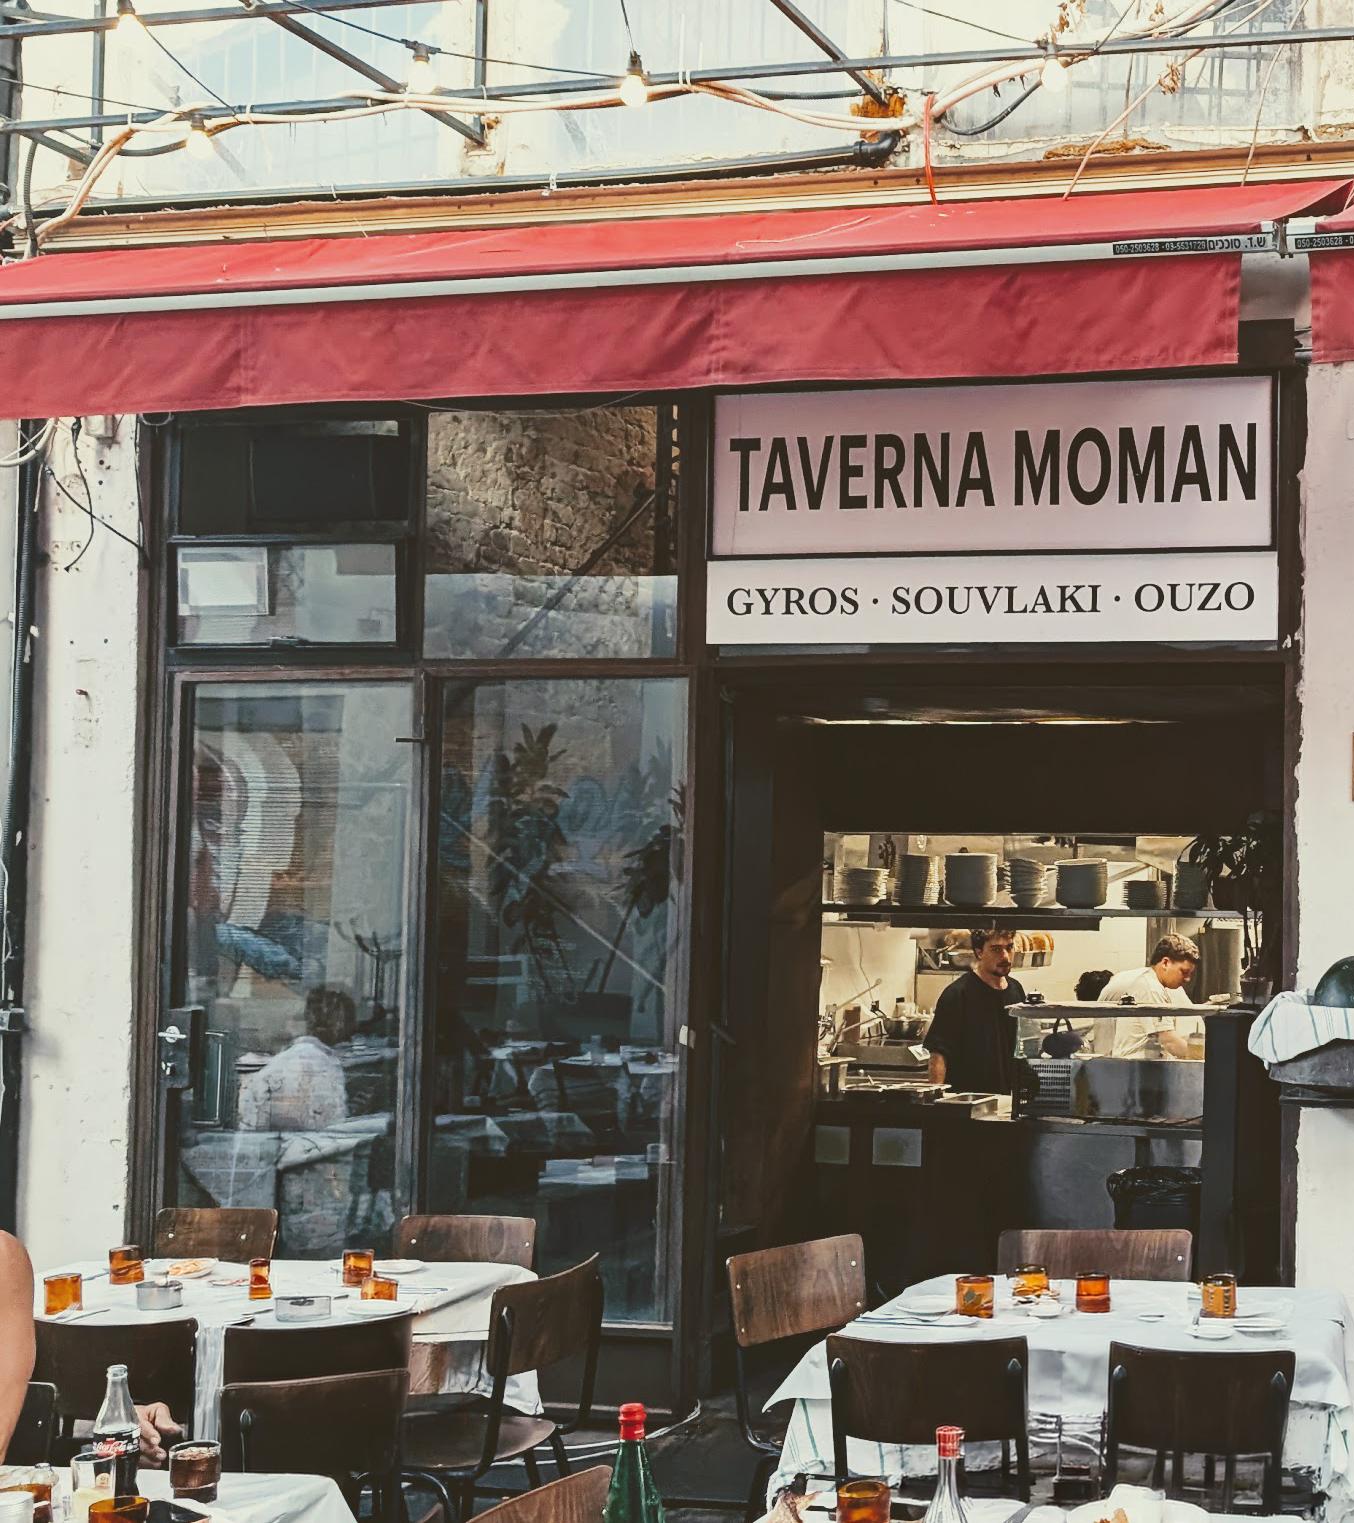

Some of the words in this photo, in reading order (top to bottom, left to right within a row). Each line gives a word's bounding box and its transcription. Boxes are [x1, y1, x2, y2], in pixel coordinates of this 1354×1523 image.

[1208, 238, 1241, 251] סוככים
[729, 431, 996, 512] TAVERNA
[1014, 422, 1257, 506] MOMAN
[727, 587, 859, 616] GYROS
[891, 585, 1102, 615] SOUVLAKI
[1134, 582, 1255, 612] OUZO
